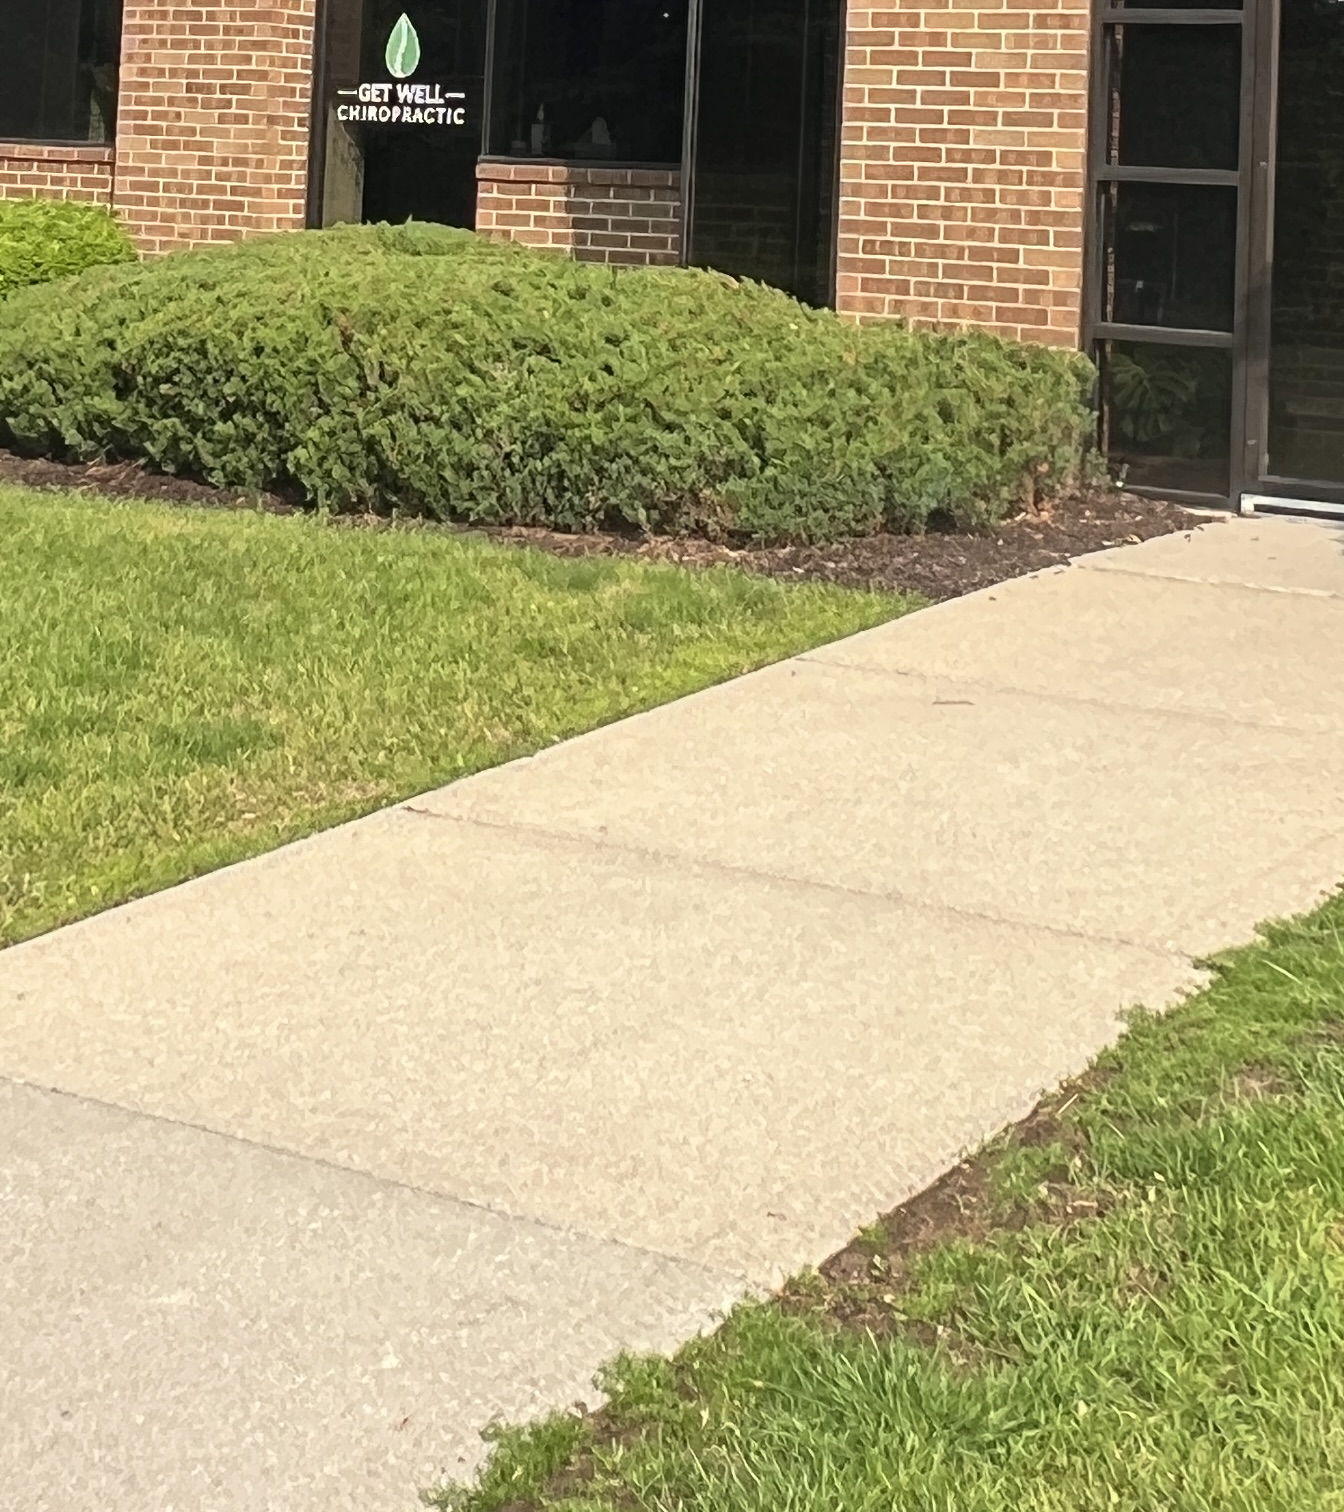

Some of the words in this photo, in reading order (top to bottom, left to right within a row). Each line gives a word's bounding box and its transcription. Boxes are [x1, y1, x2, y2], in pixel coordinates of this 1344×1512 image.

[358, 83, 393, 103] GET
[396, 83, 445, 104] WELL
[337, 104, 465, 125] CHIROPRACTIC
